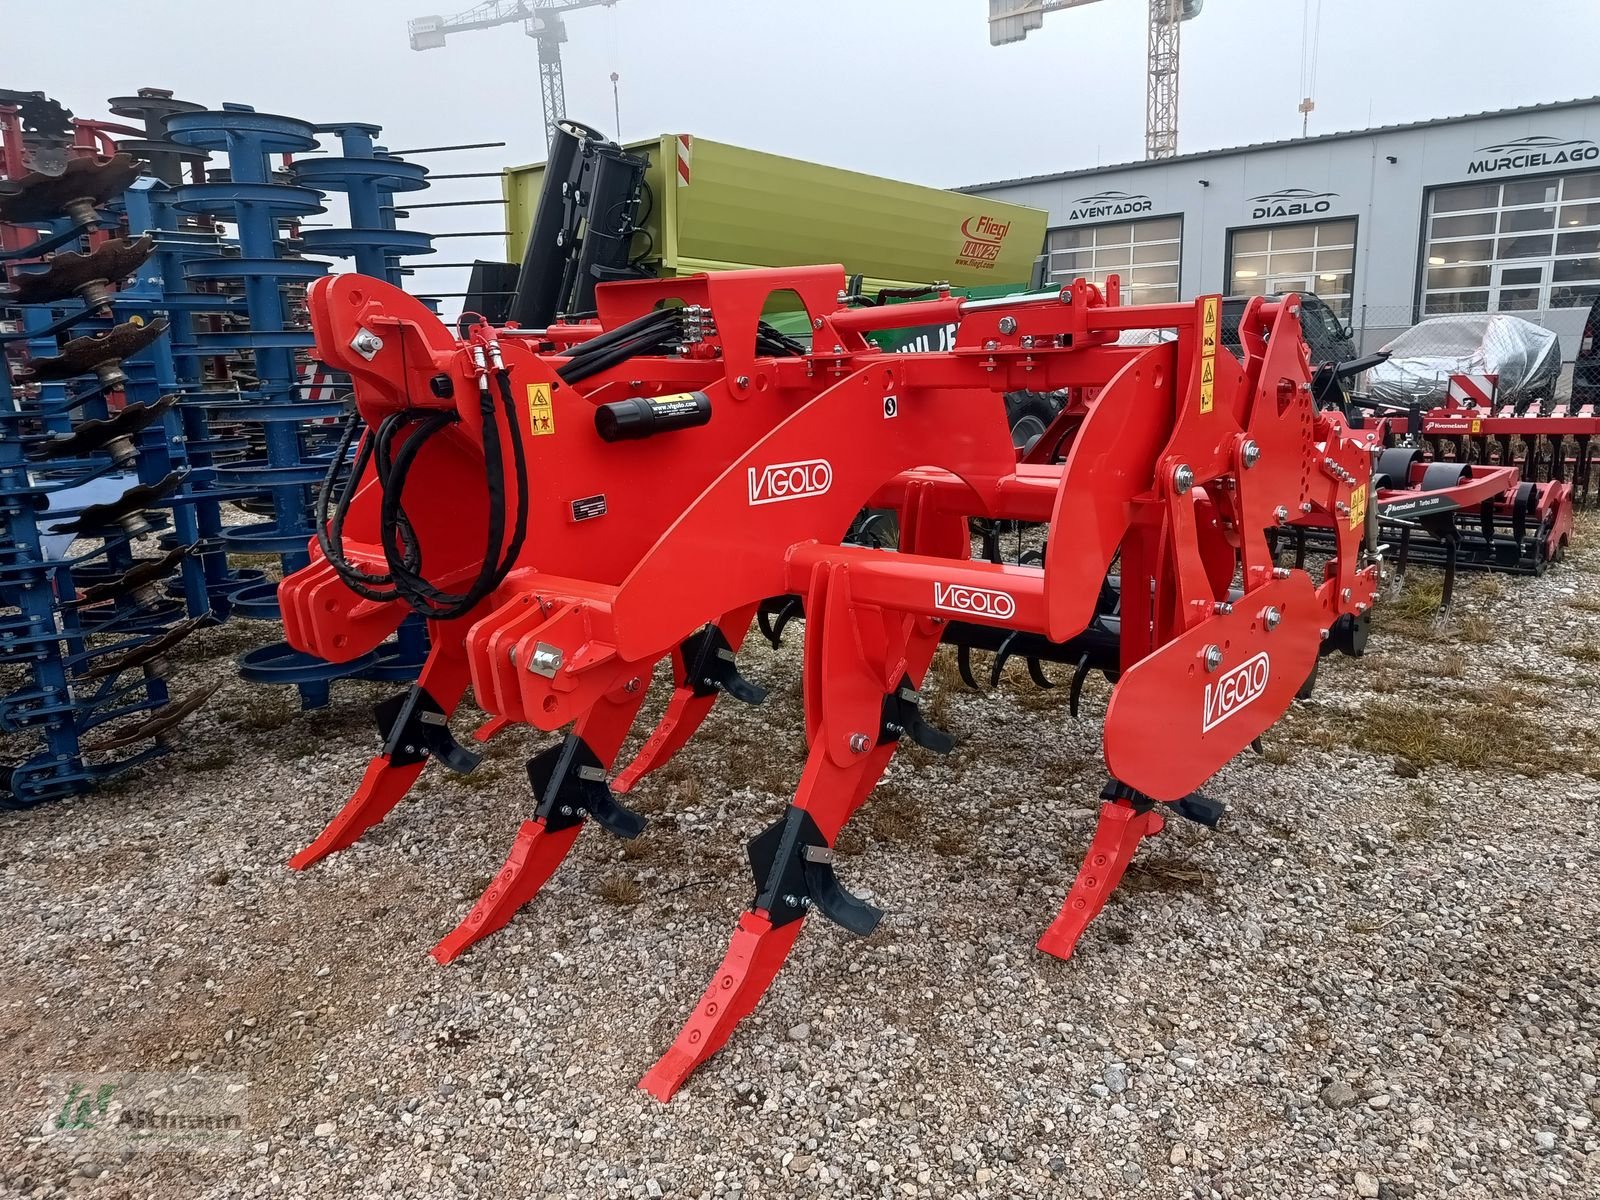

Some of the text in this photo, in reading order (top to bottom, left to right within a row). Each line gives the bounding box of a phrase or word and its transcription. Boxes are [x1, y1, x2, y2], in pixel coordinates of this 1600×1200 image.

[1467, 147, 1599, 174] MURCIELAGO
[1069, 200, 1152, 220] AVENTADOR
[1252, 200, 1330, 219] DIABLO
[975, 215, 1011, 241] Fliegl
[748, 459, 832, 506] VIGOLO
[1392, 502, 1416, 511] Kverneland
[934, 582, 1015, 619] VIGOLO
[1203, 651, 1270, 734] VIGOLO
